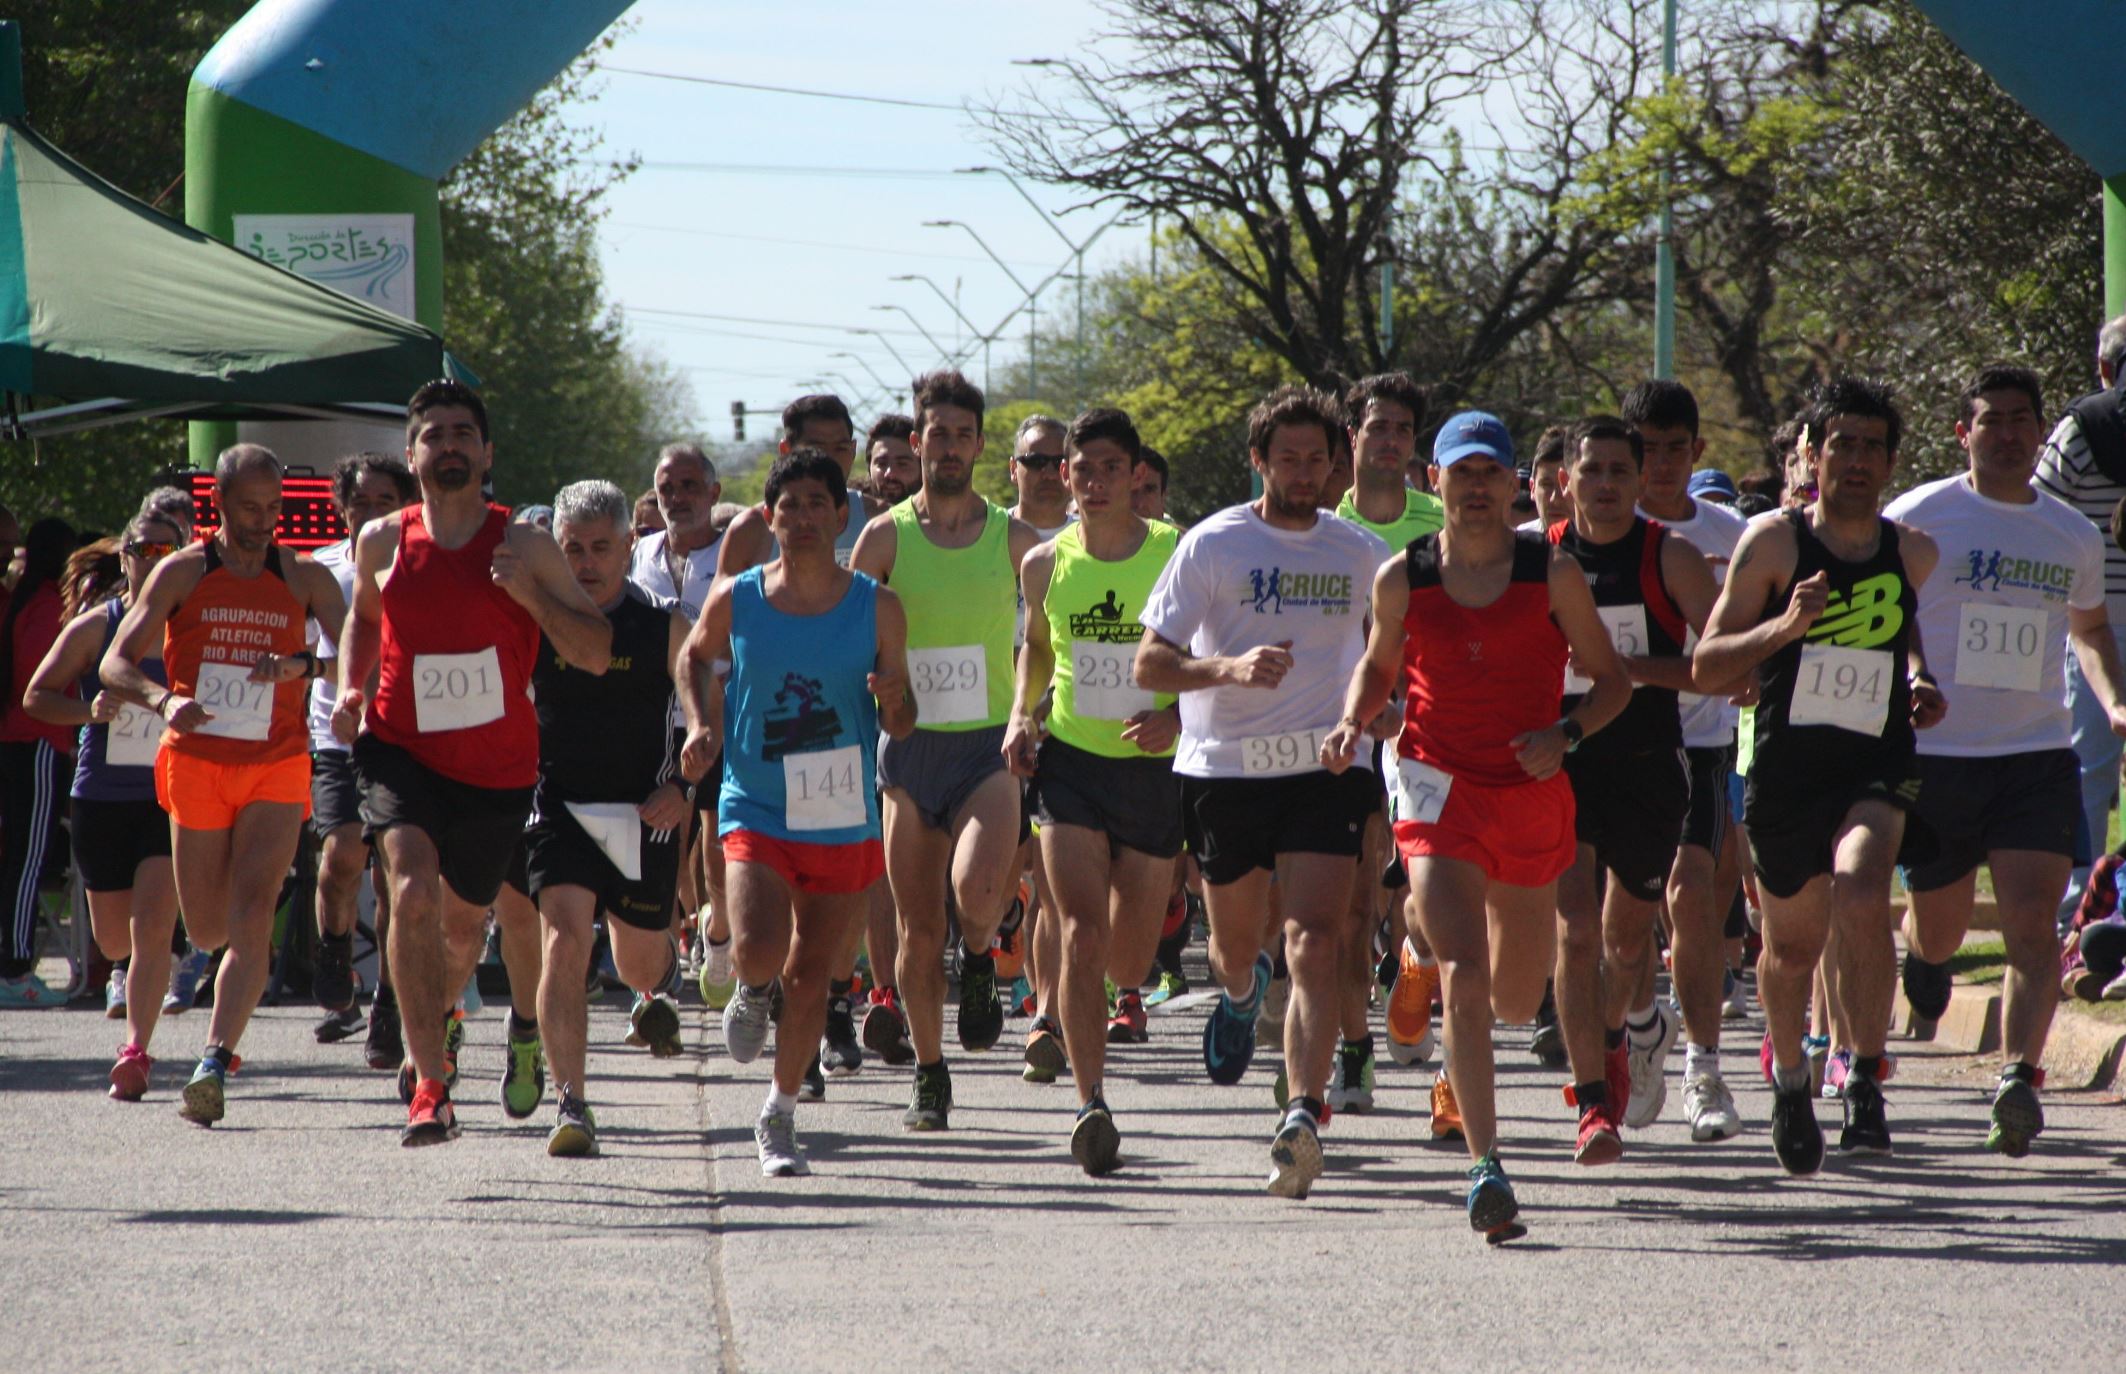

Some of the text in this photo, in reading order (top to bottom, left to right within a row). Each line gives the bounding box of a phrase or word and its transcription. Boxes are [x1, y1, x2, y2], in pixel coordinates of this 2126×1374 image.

[1279, 572, 1352, 598] CRUCE
[1998, 556, 2076, 588] CRUCE
[201, 606, 289, 629] AGRUPACION
[1071, 624, 1147, 637] CARRER
[202, 645, 226, 660] RIO
[209, 626, 272, 647] ATLETICA
[1966, 617, 2038, 657] 310
[421, 664, 494, 700] 201
[915, 658, 979, 694] 329
[1807, 660, 1882, 704] 194
[203, 676, 267, 712] 207
[115, 709, 162, 739] 27
[1250, 731, 1320, 772] 391
[795, 761, 857, 801] 144
